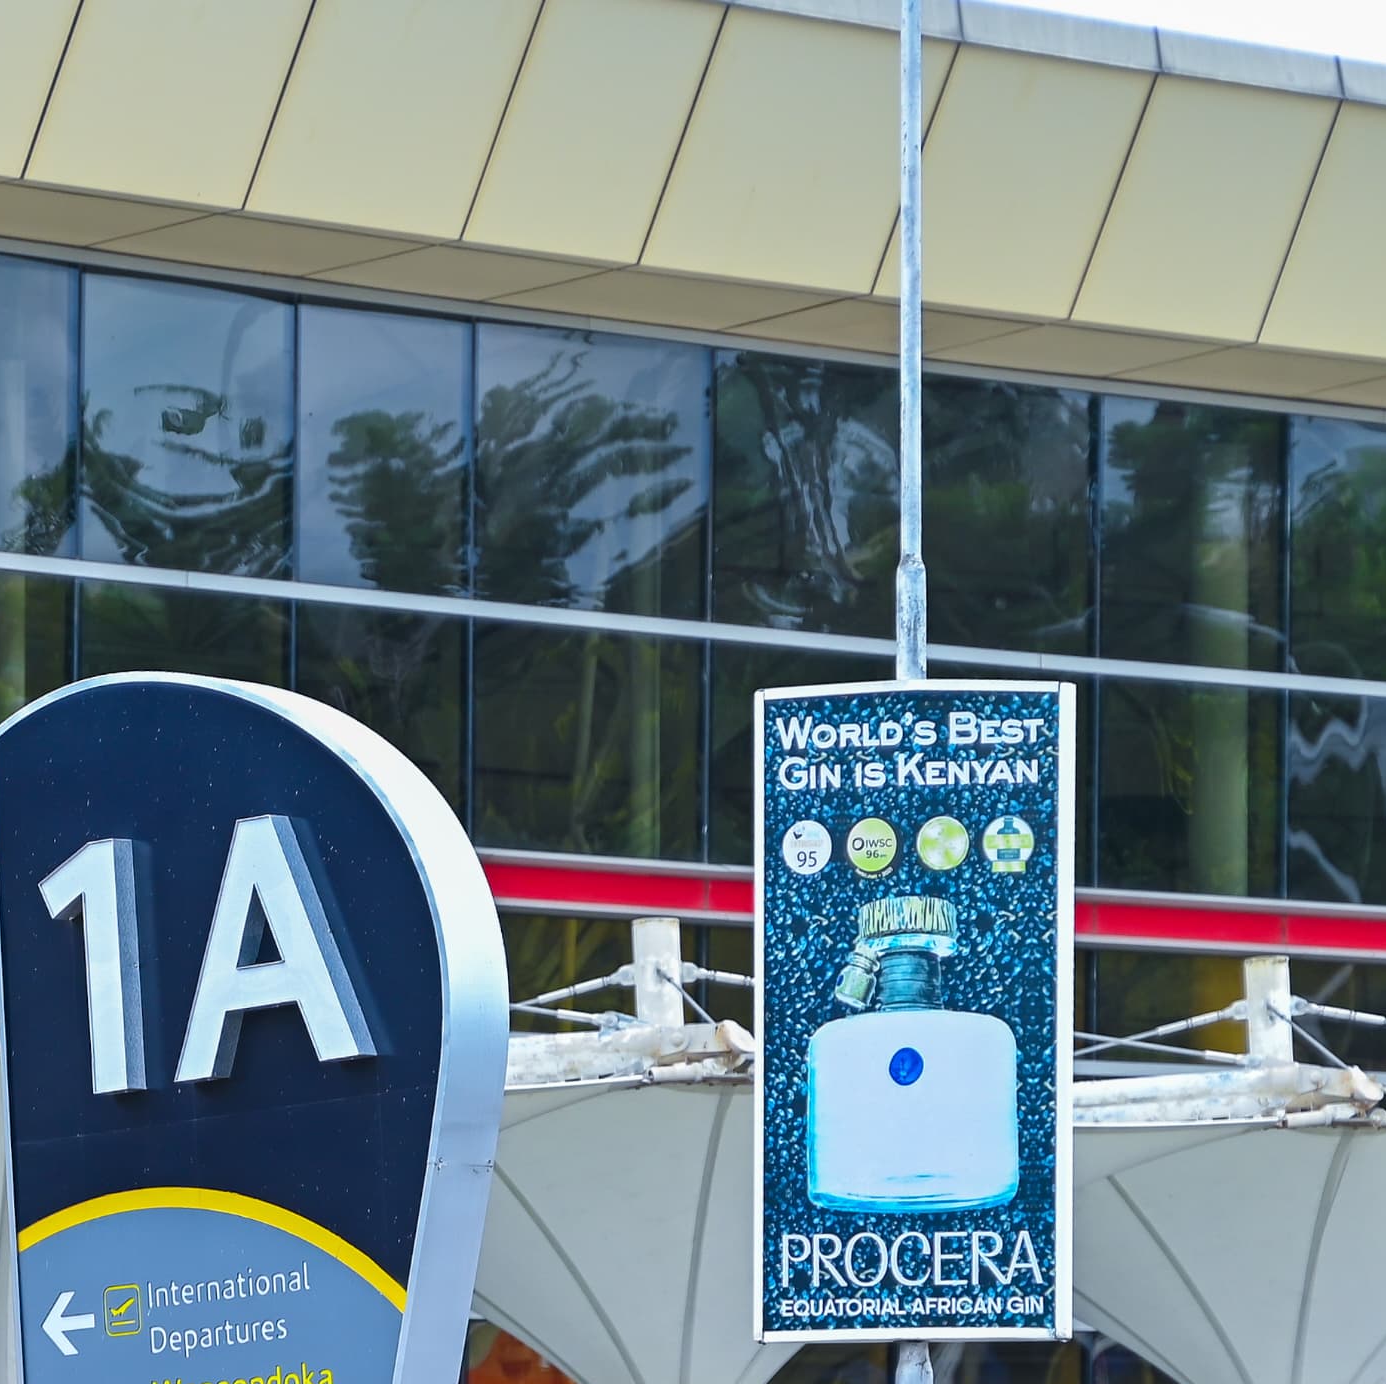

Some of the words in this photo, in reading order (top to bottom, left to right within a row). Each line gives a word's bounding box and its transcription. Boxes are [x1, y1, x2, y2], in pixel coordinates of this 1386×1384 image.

[948, 711, 1045, 746] BEST
[778, 757, 841, 790] GIN
[855, 760, 886, 787] IS
[896, 753, 1039, 786] KENYAN
[796, 850, 818, 868] 95
[865, 838, 893, 848] IWSC
[865, 849, 880, 859] 96
[38, 814, 377, 1095] 1A
[781, 1230, 1045, 1288] PROCERA
[146, 1261, 312, 1311] International
[780, 1298, 907, 1318] EQUATORIAL
[912, 1297, 1002, 1316] AFRICAN
[1005, 1295, 1045, 1315] GIN
[149, 1316, 288, 1358] Departures
